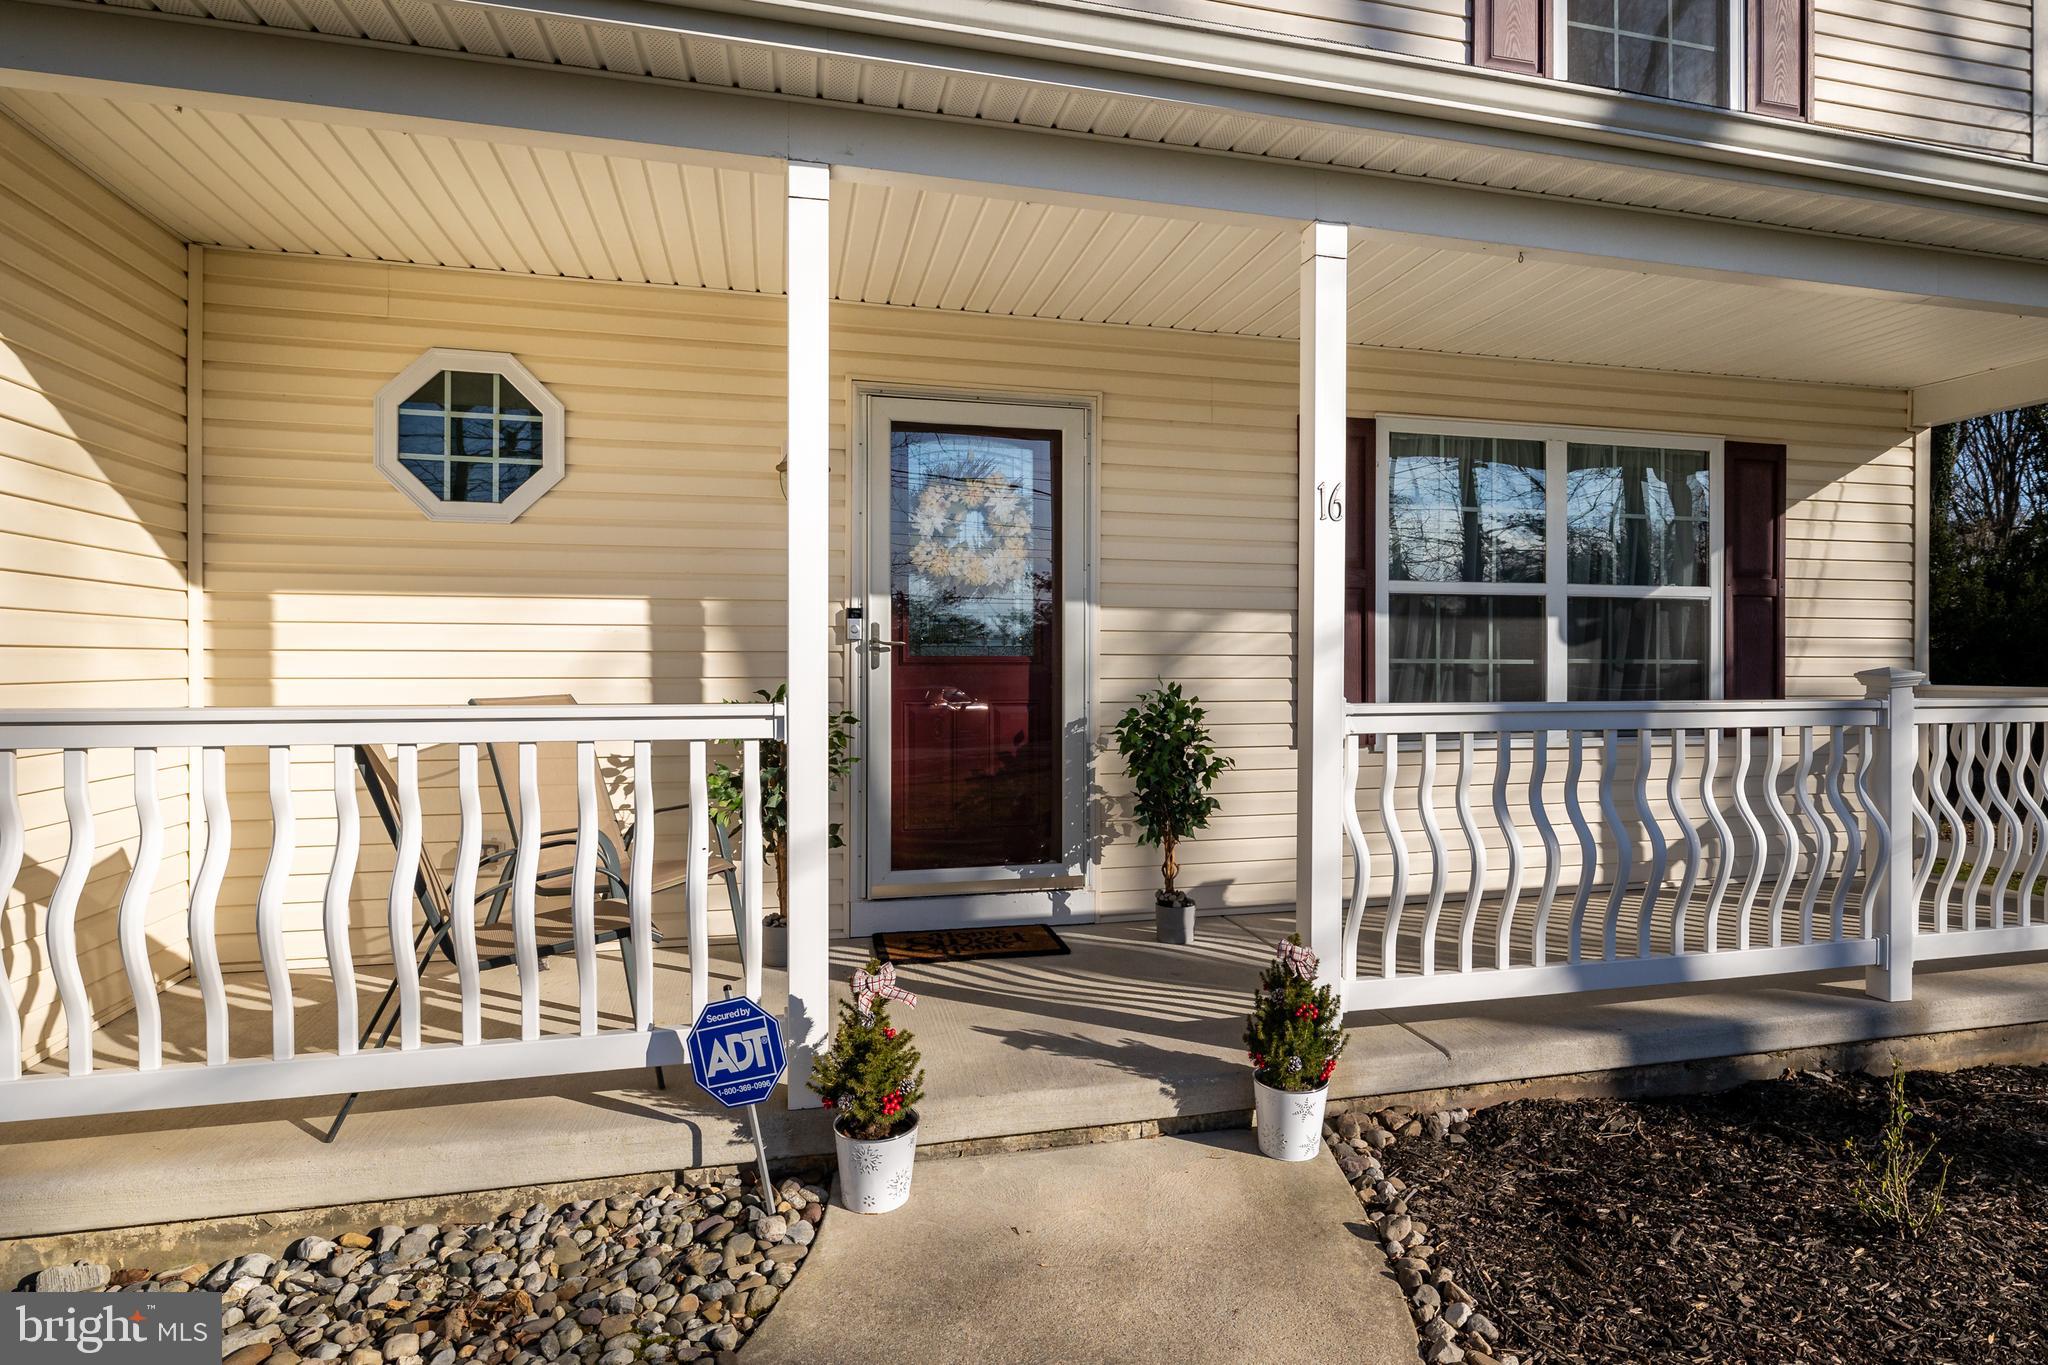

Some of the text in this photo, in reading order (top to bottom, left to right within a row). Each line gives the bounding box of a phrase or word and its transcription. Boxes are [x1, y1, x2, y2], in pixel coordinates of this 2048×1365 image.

[1317, 481, 1343, 522] 16
[706, 1007, 751, 1023] Secured by
[707, 1027, 768, 1078] ADT
